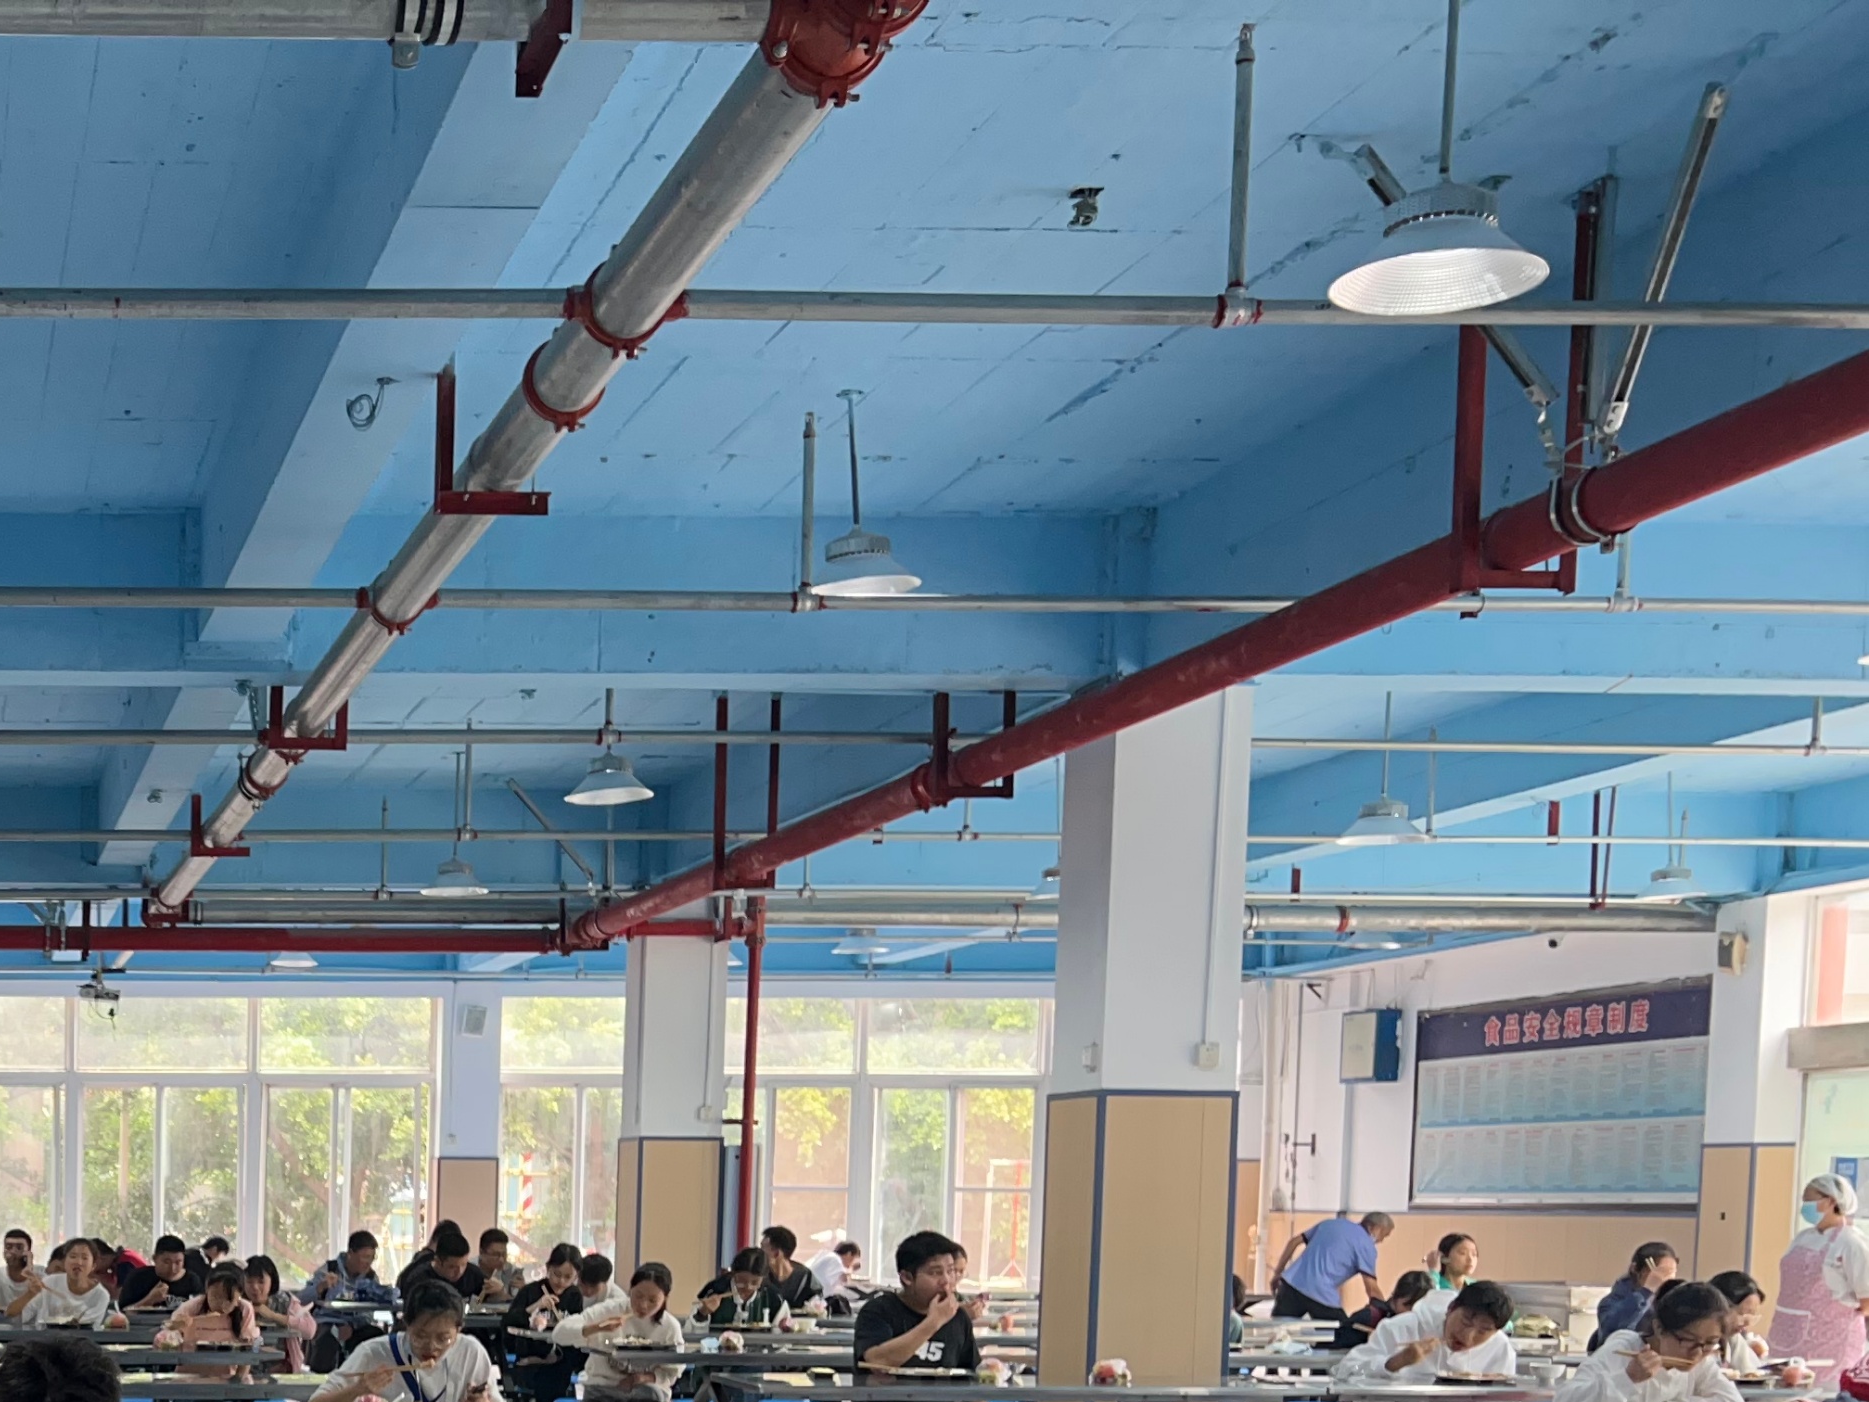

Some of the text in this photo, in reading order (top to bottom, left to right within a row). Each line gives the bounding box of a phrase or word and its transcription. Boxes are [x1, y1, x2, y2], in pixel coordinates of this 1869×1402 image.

[1484, 998, 1650, 1047] 食品安全规章制度
